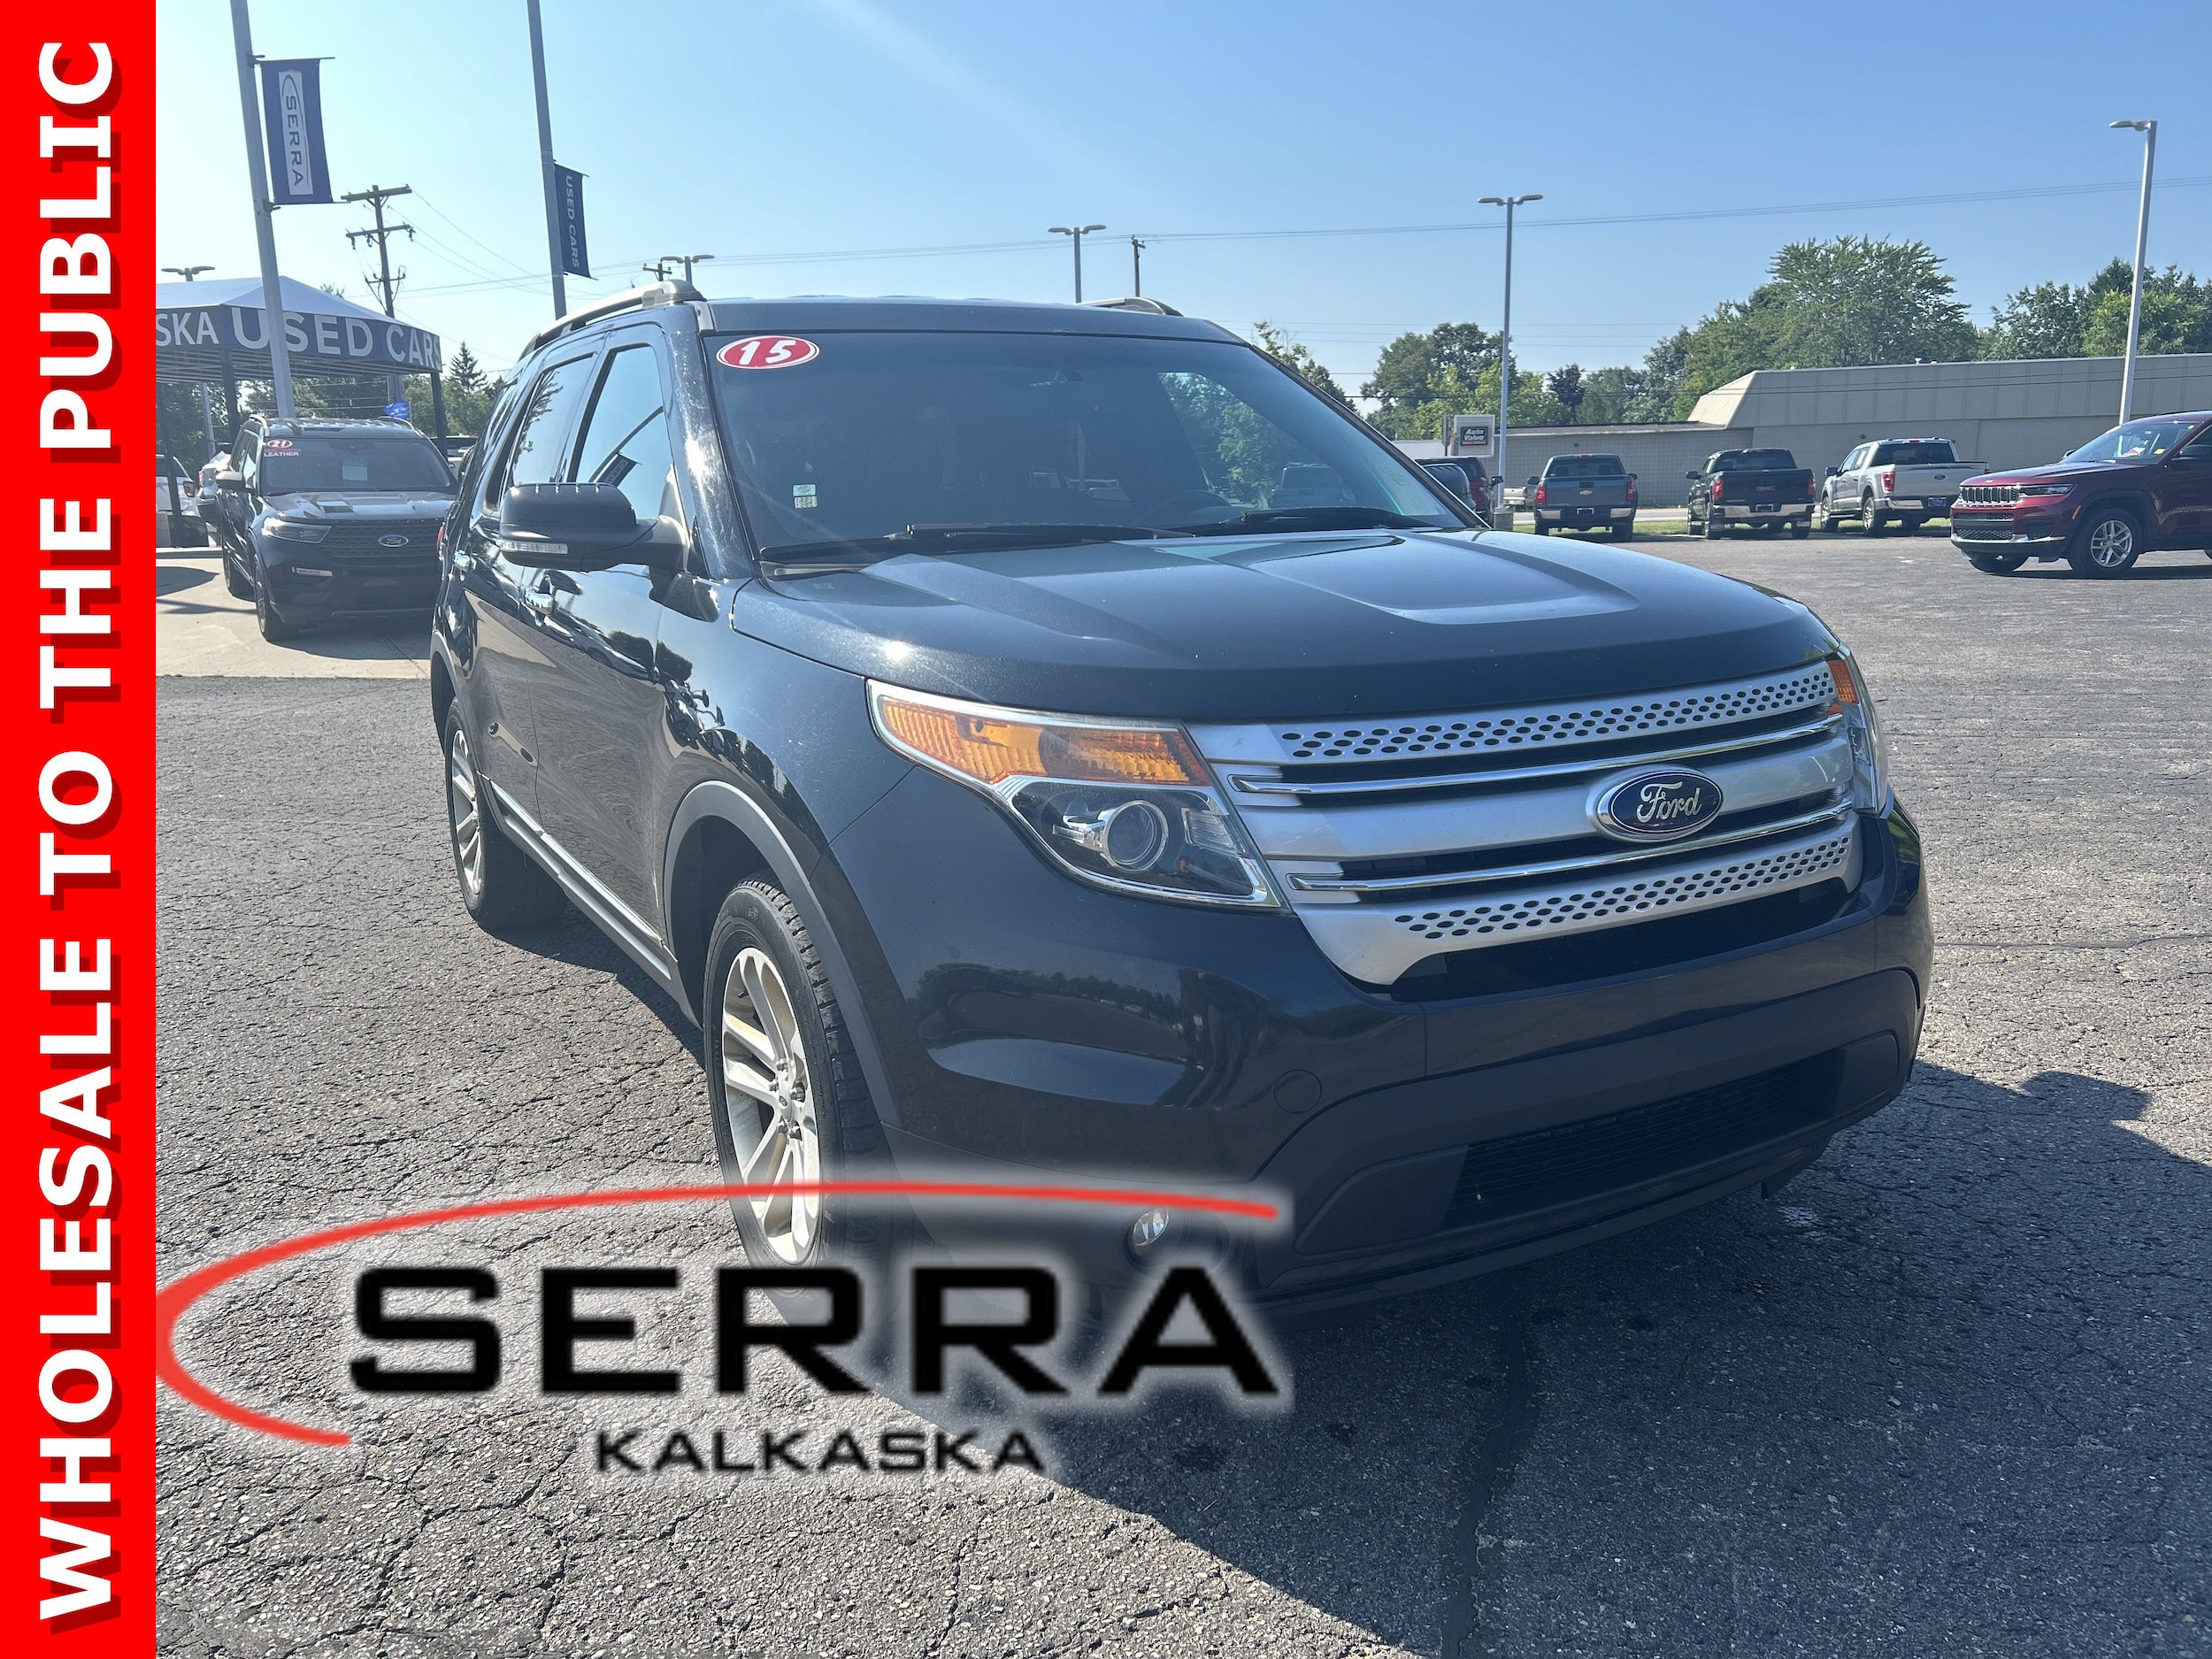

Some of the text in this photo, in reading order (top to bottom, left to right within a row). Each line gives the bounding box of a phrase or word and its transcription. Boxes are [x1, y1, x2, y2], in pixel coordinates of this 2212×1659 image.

[286, 95, 304, 186] SERRA
[565, 175, 580, 268] USED CARS
[231, 307, 373, 357] USED
[386, 323, 442, 370] CARS
[738, 340, 797, 365] 15
[271, 439, 287, 448] 21
[1636, 781, 1703, 823] Ford
